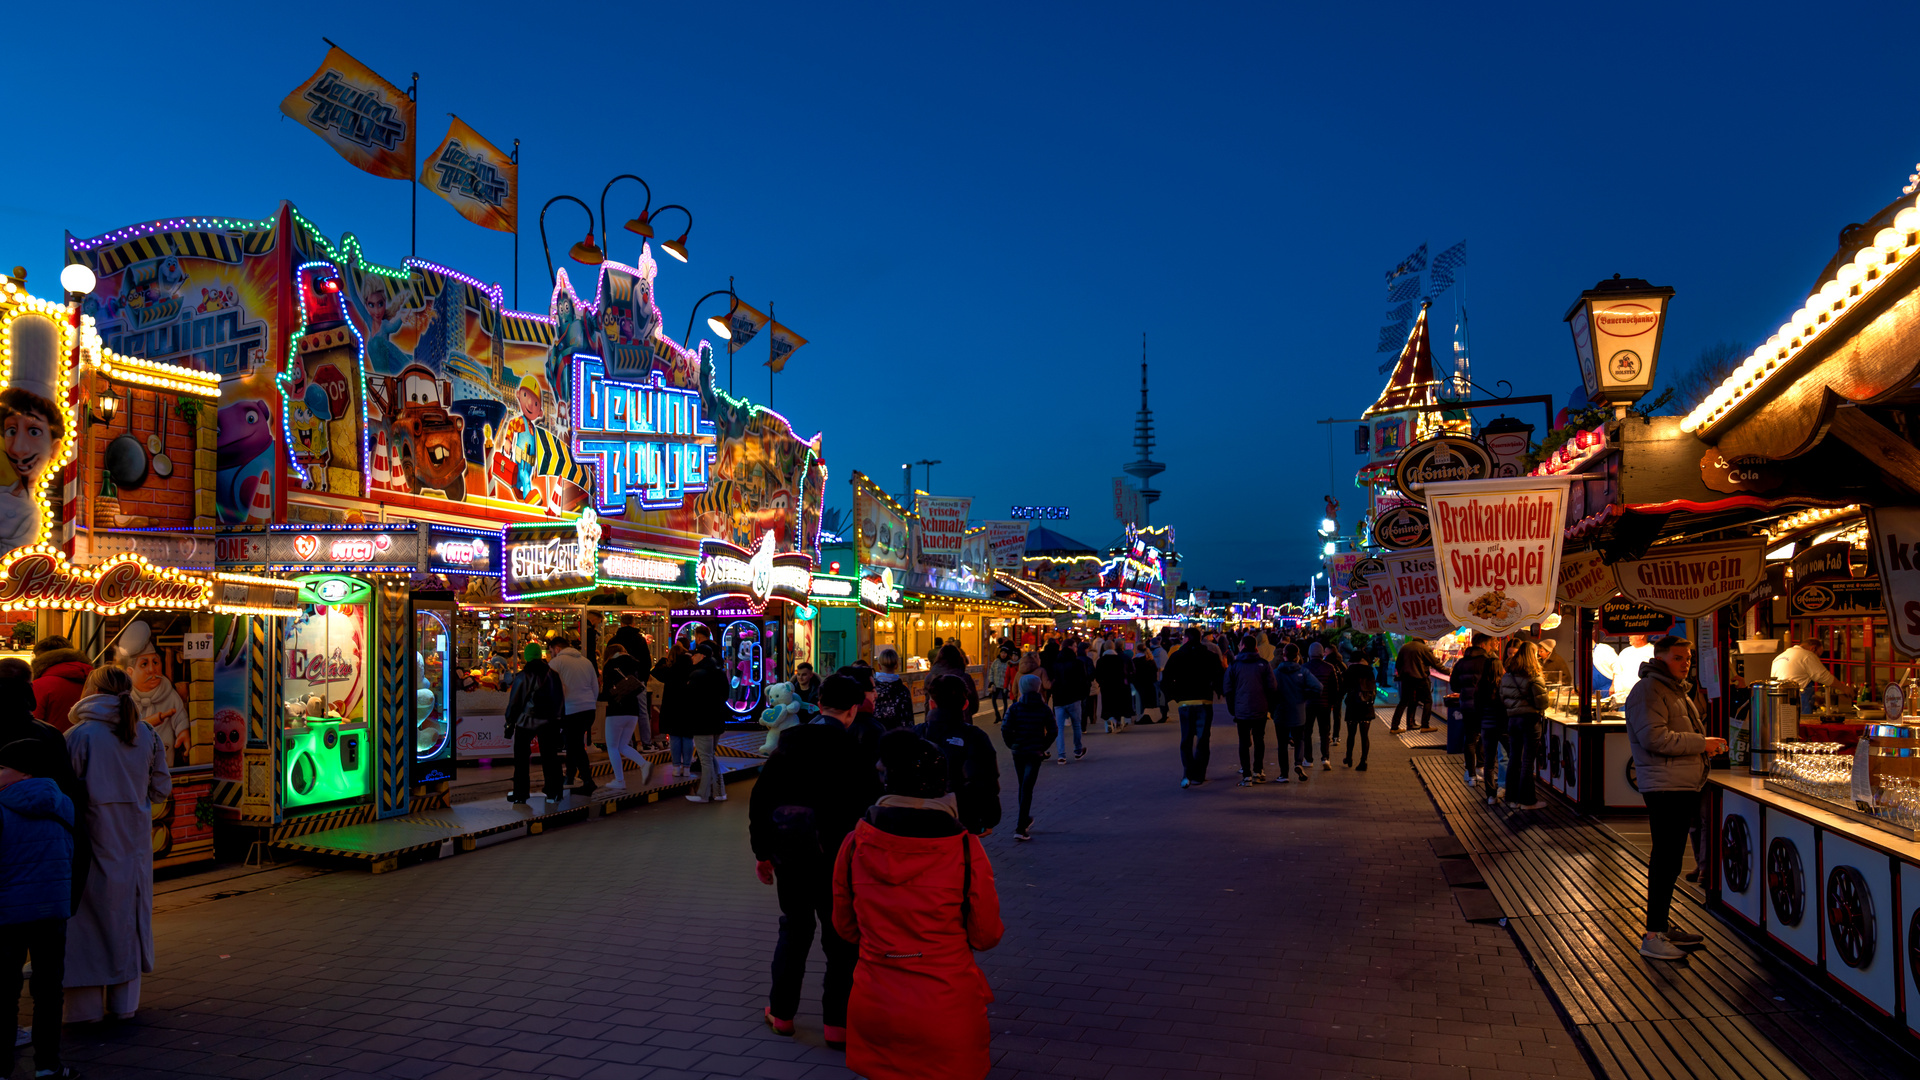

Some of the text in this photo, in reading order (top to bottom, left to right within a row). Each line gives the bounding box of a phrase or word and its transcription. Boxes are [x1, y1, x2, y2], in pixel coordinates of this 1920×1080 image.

[1406, 463, 1481, 483] Gröninger
[1727, 469, 1759, 484] Cola
[928, 507, 961, 517] Frische
[1011, 505, 1070, 519] ROTOR
[1437, 495, 1554, 544] Bratkartoffeln
[922, 533, 963, 550] kuchen
[1380, 522, 1430, 541] Gröninger
[989, 535, 1025, 549] nutella
[610, 557, 646, 577] BAGGERN
[1450, 545, 1545, 594] Spiegelei
[1637, 556, 1742, 587] Glühwein
[92, 560, 204, 607] Cuisine
[1565, 566, 1605, 600] Bowle
[187, 640, 210, 650] B 197
[306, 653, 353, 683] Claw
